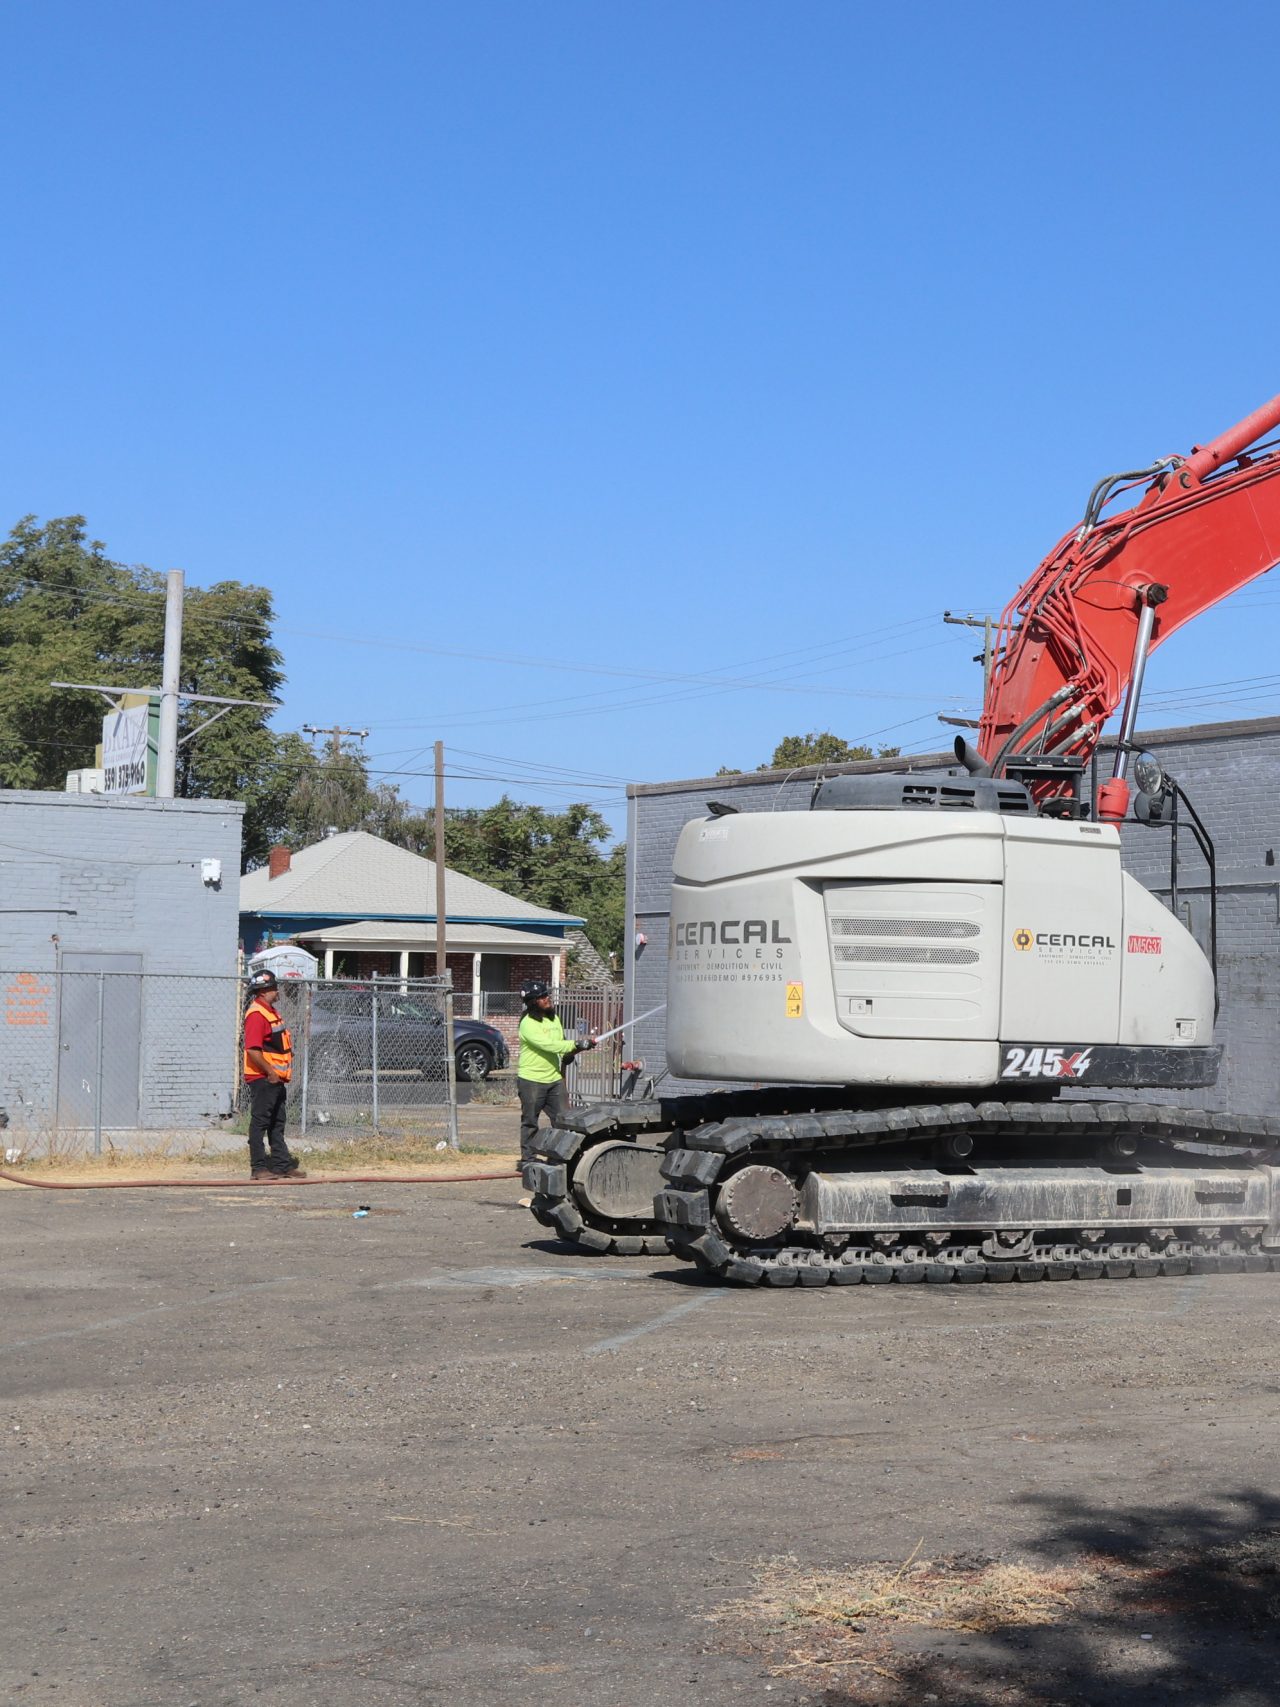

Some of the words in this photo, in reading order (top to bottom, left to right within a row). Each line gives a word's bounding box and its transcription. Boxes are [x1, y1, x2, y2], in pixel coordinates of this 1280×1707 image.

[676, 919, 792, 946] CENCAL
[1036, 933, 1115, 948] CENCAL
[676, 947, 783, 960] SERVICES
[1038, 947, 1112, 955] SERVICES
[706, 962, 749, 970] DEMOLITION
[761, 962, 783, 970] CIVIL
